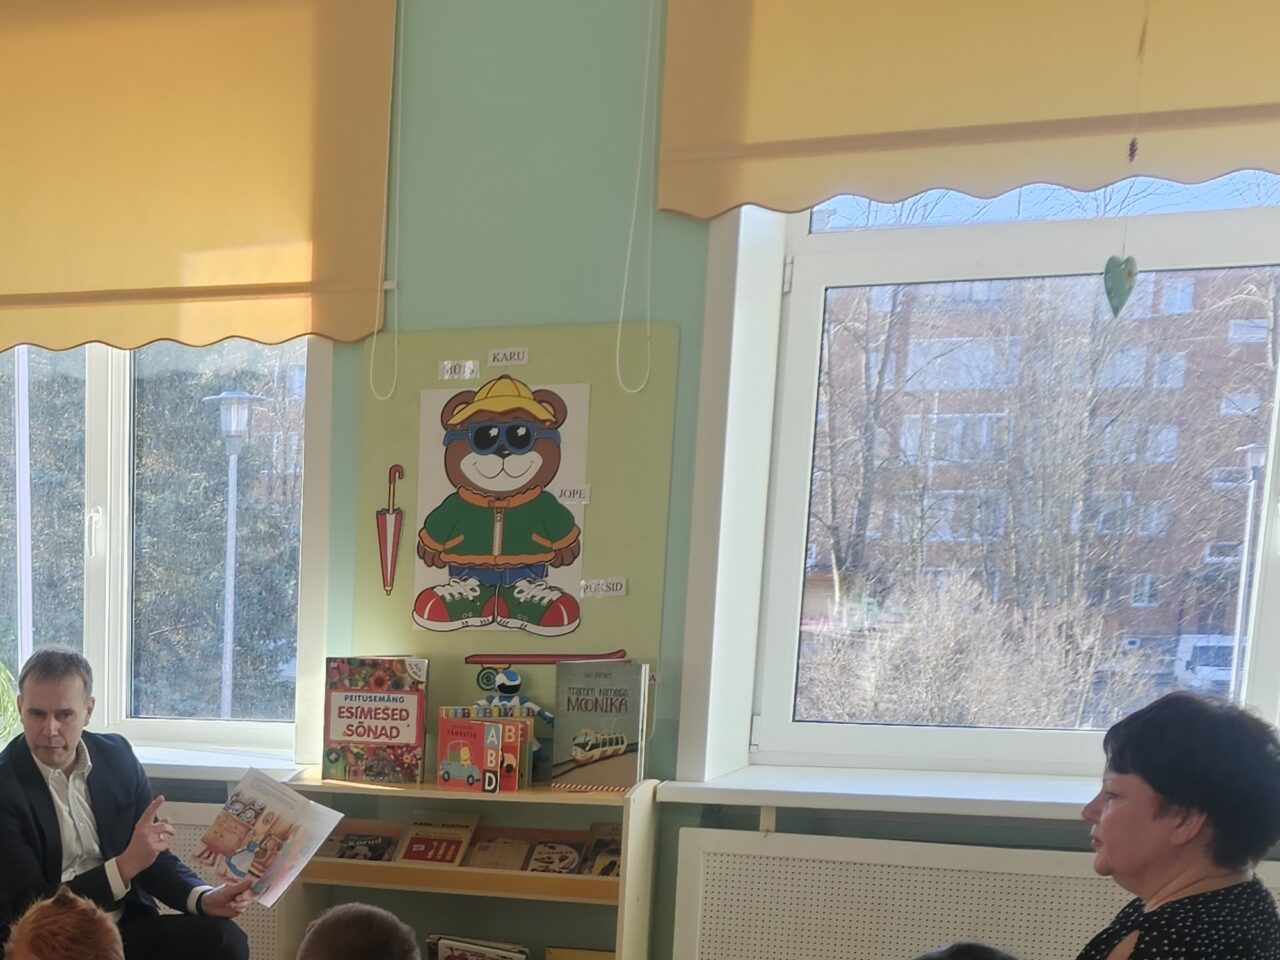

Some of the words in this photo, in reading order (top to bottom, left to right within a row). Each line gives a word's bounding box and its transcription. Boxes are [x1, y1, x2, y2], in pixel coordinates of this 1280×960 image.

[492, 350, 526, 362] KARU
[559, 488, 586, 499] JOPE
[344, 694, 405, 703] PEITUSEMÄNG
[567, 696, 628, 713] MOONIKA
[337, 705, 410, 722] ESIMESED
[344, 721, 400, 740] SÕNAD
[487, 727, 498, 745] A
[505, 725, 516, 742] B
[487, 750, 496, 768] B
[485, 772, 496, 790] D
